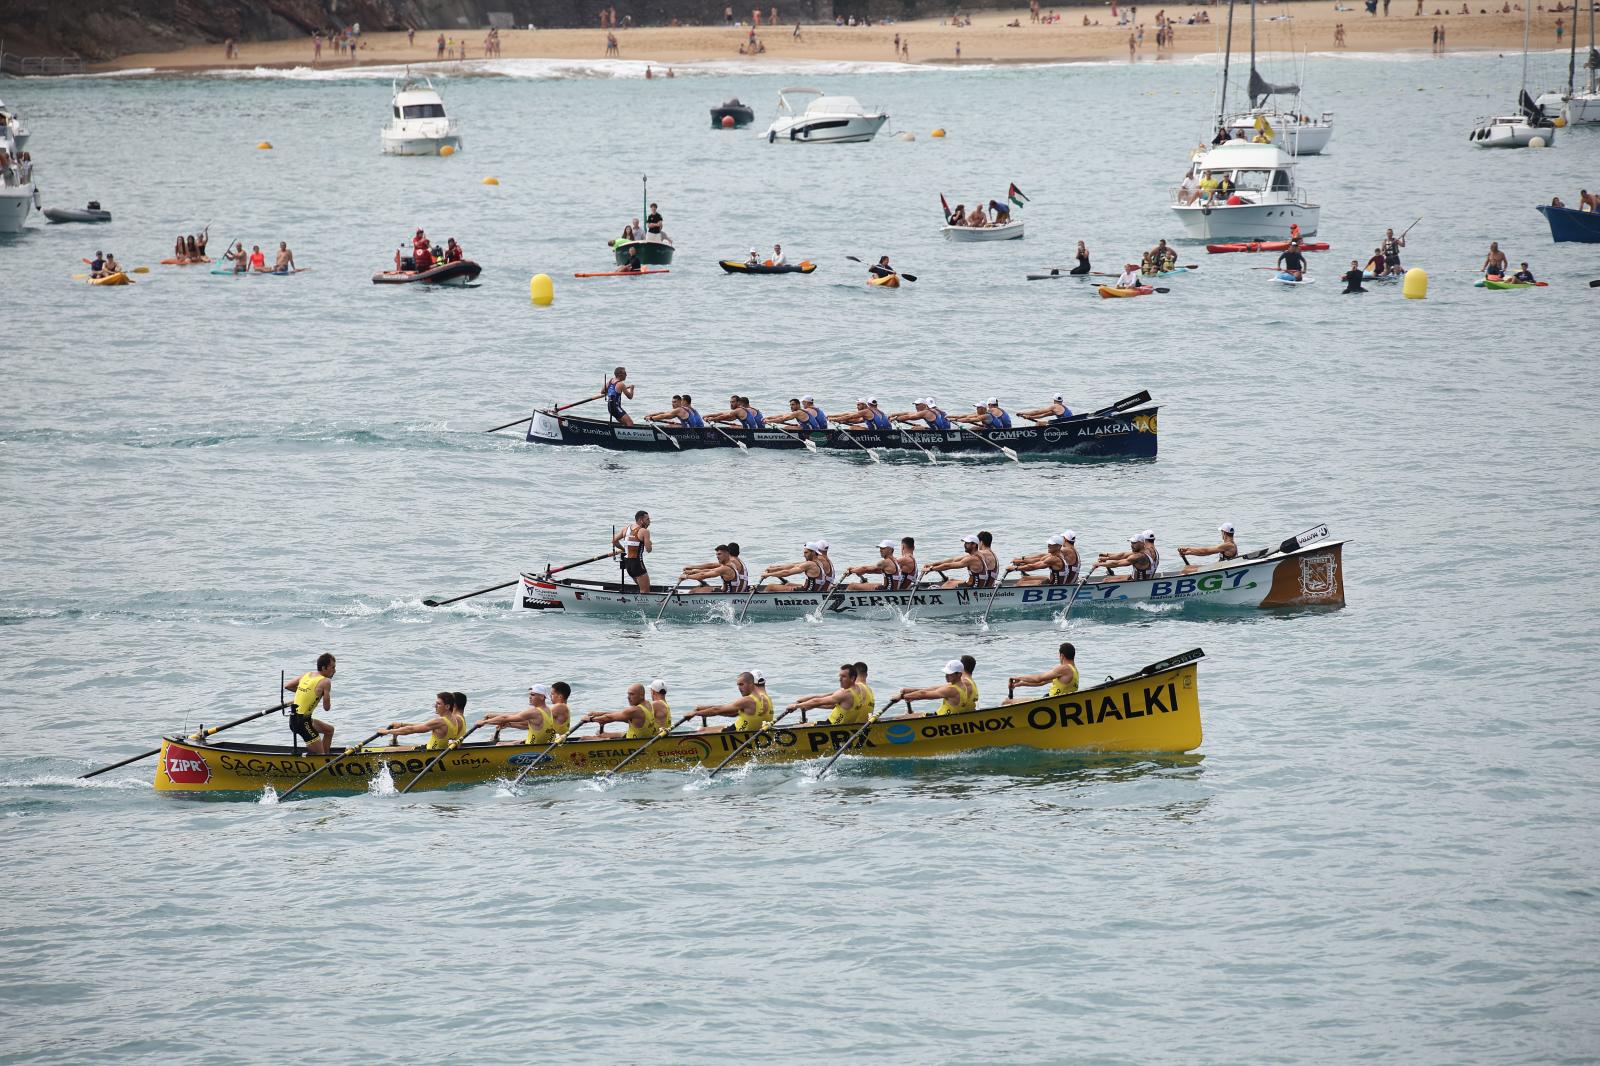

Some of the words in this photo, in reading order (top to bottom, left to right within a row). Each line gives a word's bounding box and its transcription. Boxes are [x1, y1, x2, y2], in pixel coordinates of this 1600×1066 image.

[988, 429, 1038, 441] CAMPOS
[1077, 421, 1150, 437] ALAKRANA
[1027, 683, 1180, 731] ORIALKI
[921, 715, 1015, 738] ORBINOX
[220, 755, 318, 775] SAGARDI
